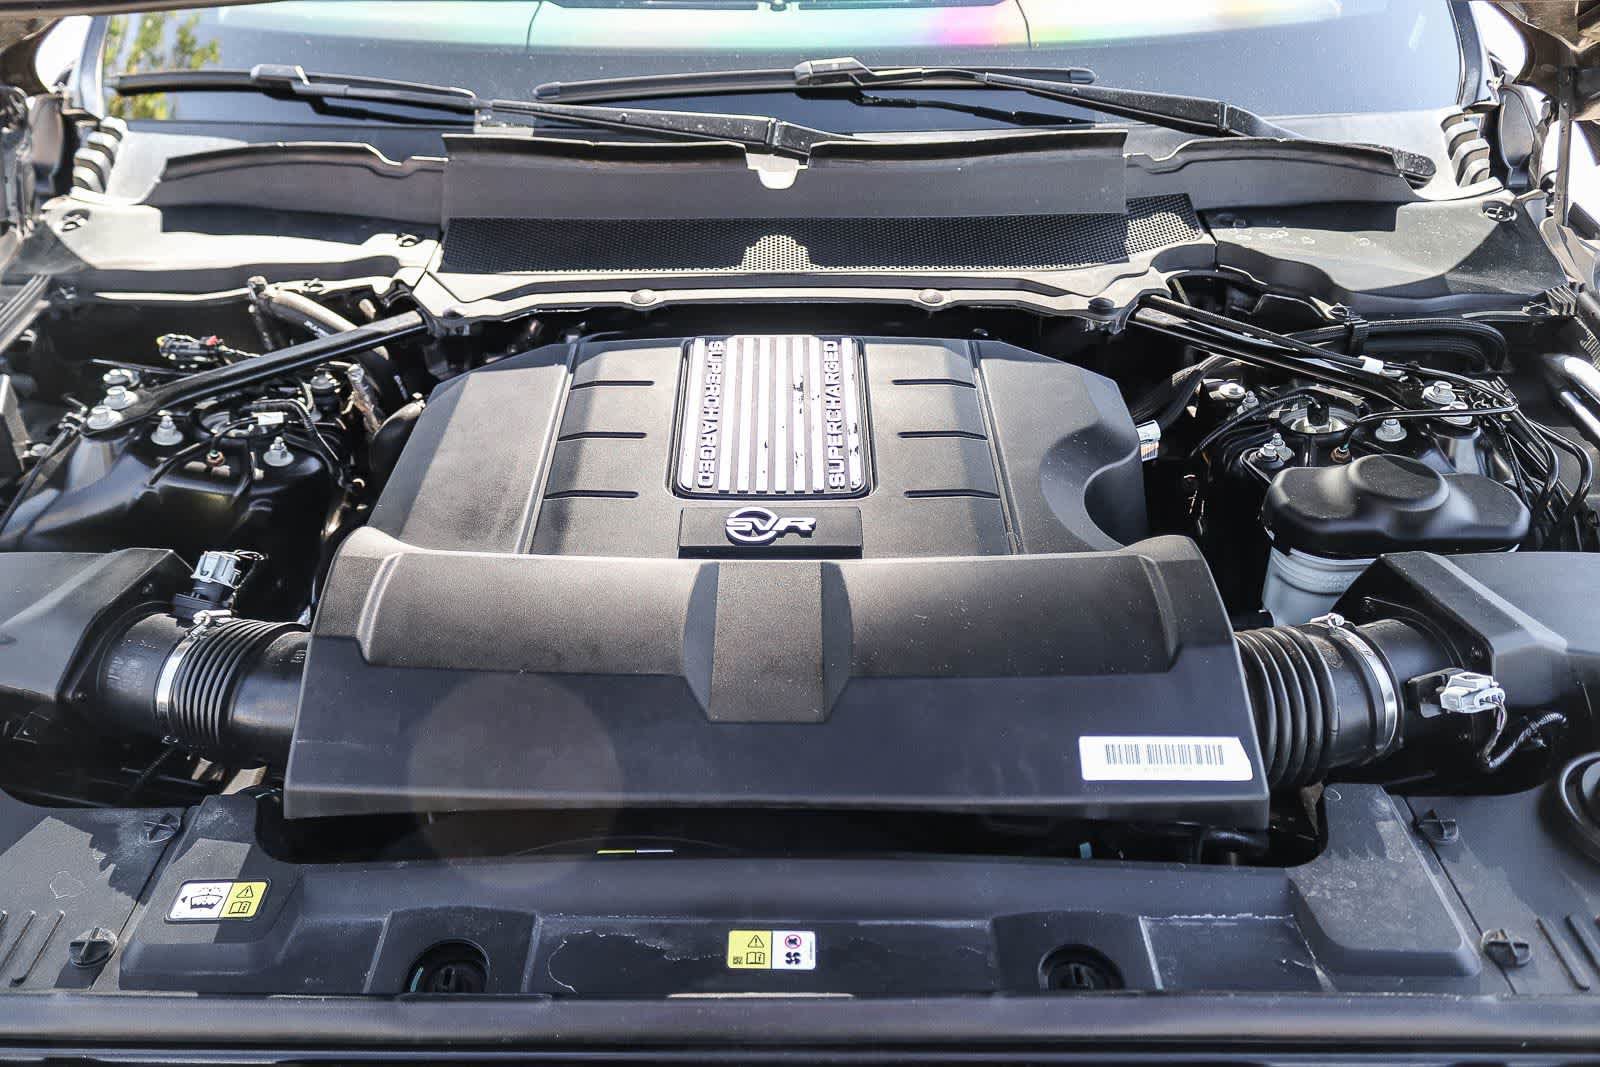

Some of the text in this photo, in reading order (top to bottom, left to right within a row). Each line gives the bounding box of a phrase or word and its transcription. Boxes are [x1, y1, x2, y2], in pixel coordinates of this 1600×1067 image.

[697, 340, 723, 488] SUPERCHARGED
[823, 340, 846, 489] SUPERCHARGED
[726, 511, 816, 542] SVR
